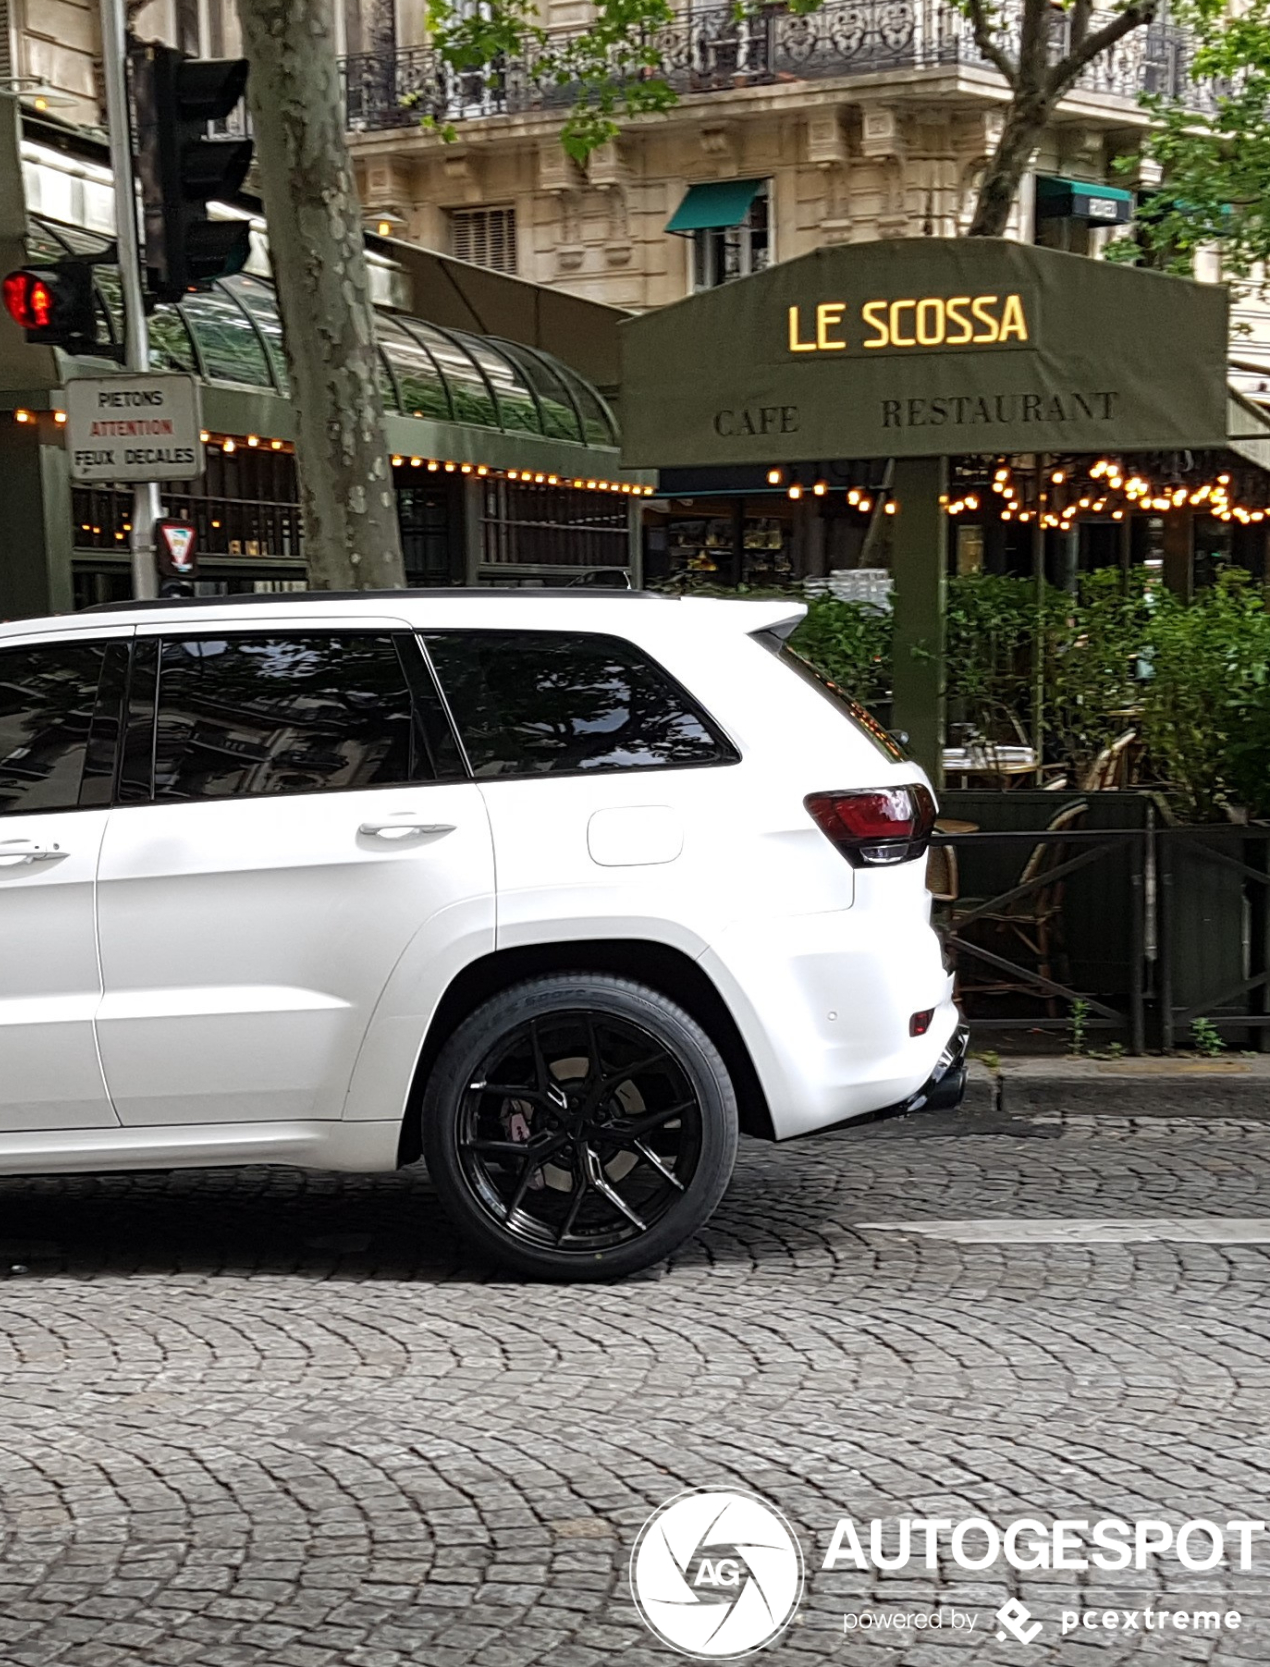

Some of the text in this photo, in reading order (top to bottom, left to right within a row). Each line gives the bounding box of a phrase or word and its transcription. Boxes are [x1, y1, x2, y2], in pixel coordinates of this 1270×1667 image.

[788, 294, 1029, 351] LE SCOSSA
[97, 390, 164, 407] PIETONS
[712, 391, 1120, 438] CAFE RESTAURANT
[89, 419, 174, 437] ATTENTION
[74, 447, 195, 466] FEUX DECALES
